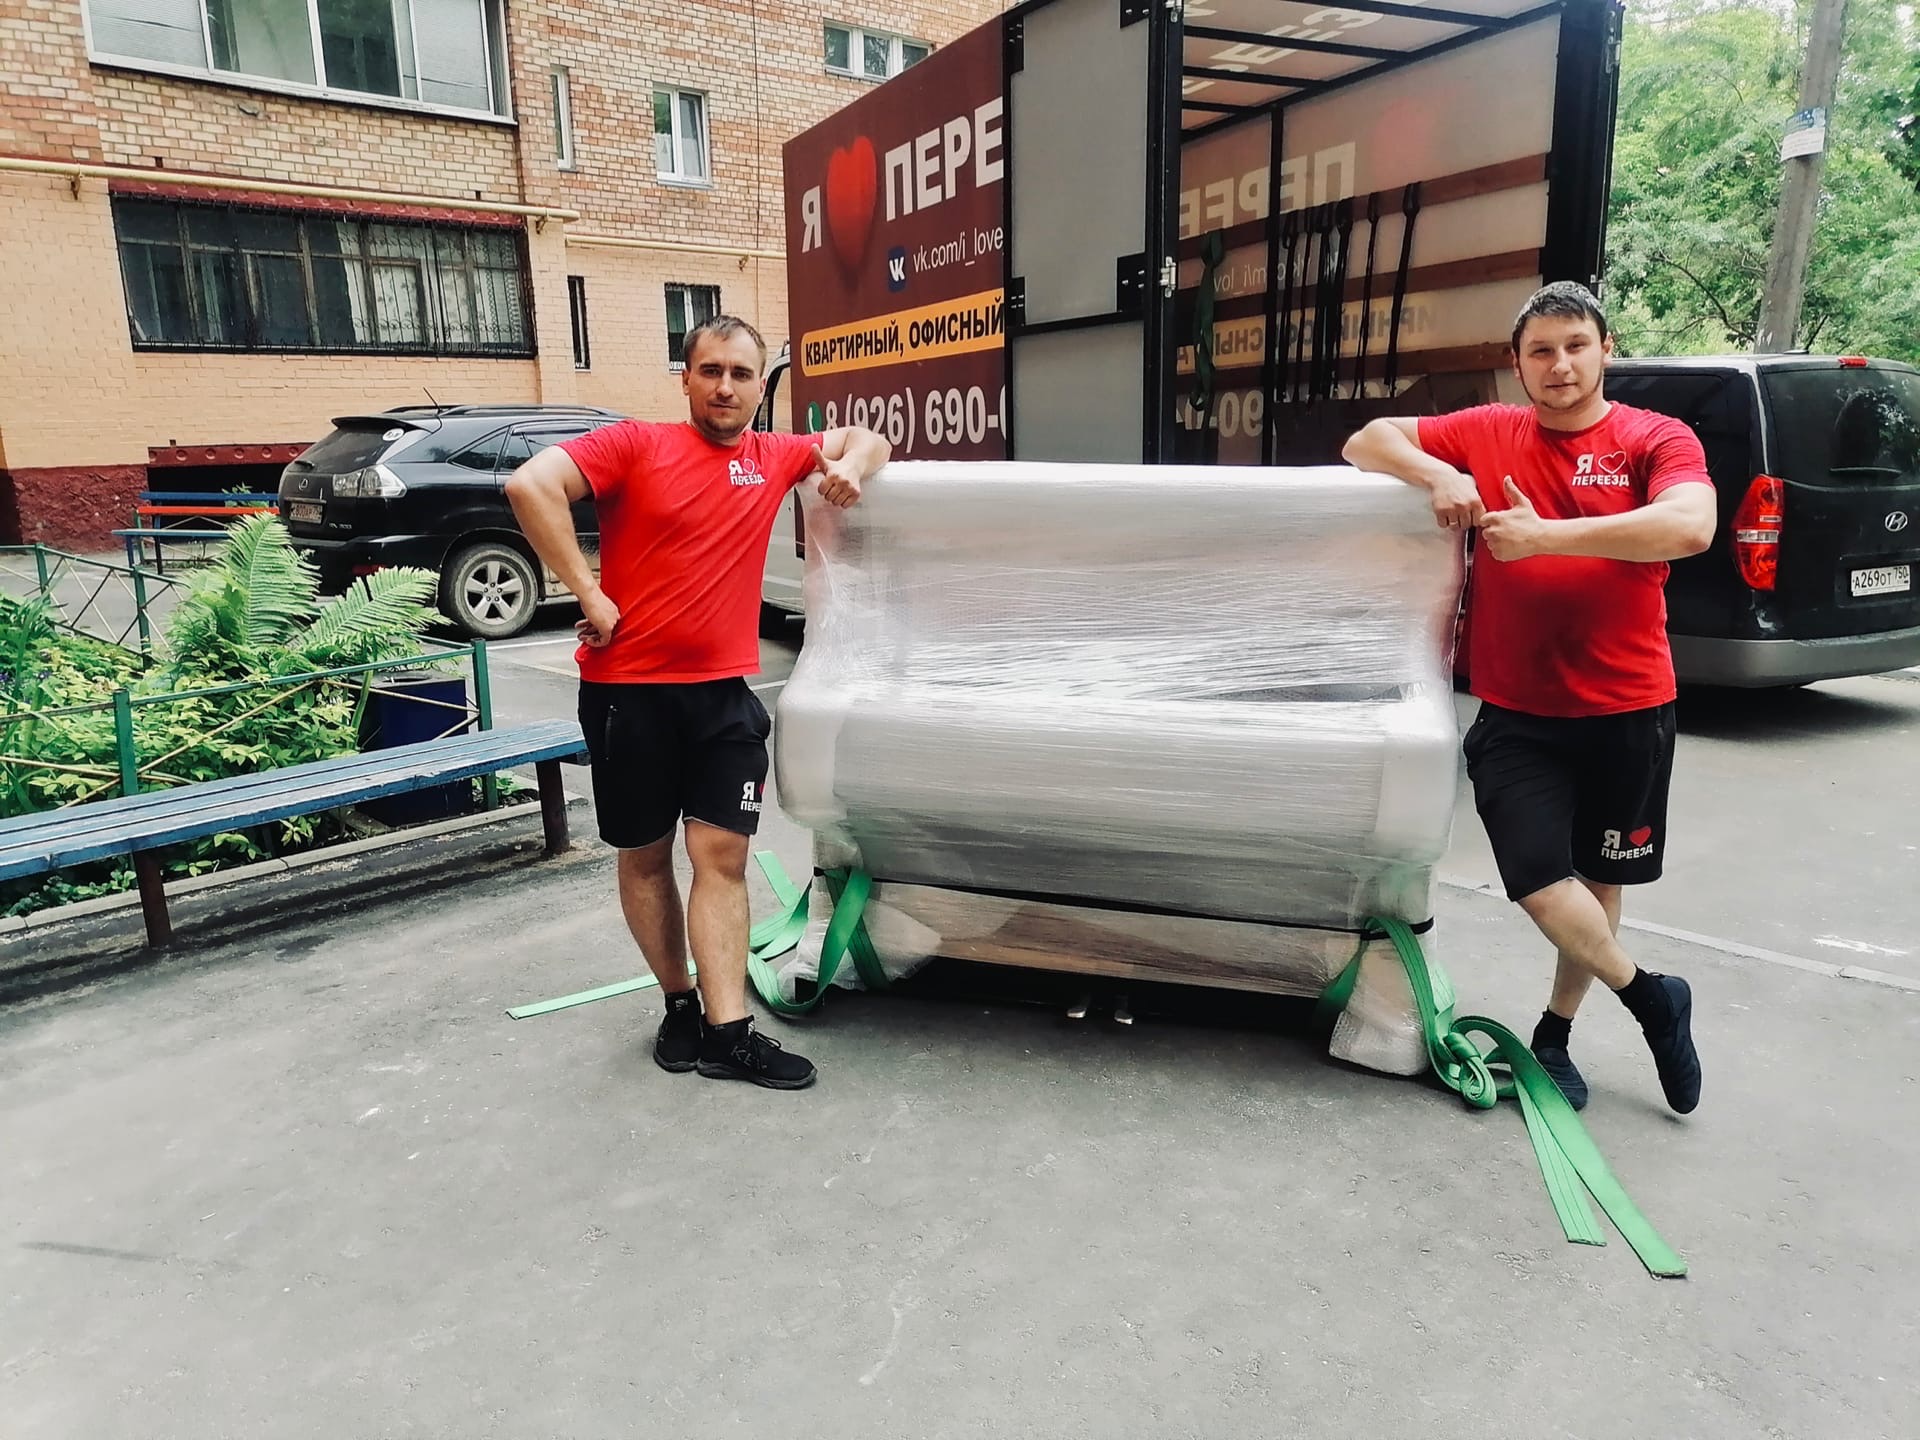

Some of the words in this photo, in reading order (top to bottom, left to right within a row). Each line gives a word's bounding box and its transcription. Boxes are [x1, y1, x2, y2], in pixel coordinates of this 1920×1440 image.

[802, 185, 822, 253] Я
[805, 319, 904, 367] КВАРТИРНЫЙ,
[909, 296, 1004, 349] ОФИСНЫЙ
[728, 460, 743, 475] Я
[1575, 453, 1594, 475] Я
[1571, 474, 1630, 487] ПЕРЕЕЗД
[742, 781, 755, 801] Я
[1603, 829, 1621, 849] Я
[1601, 843, 1653, 860] ПЕРЕЕЗД
